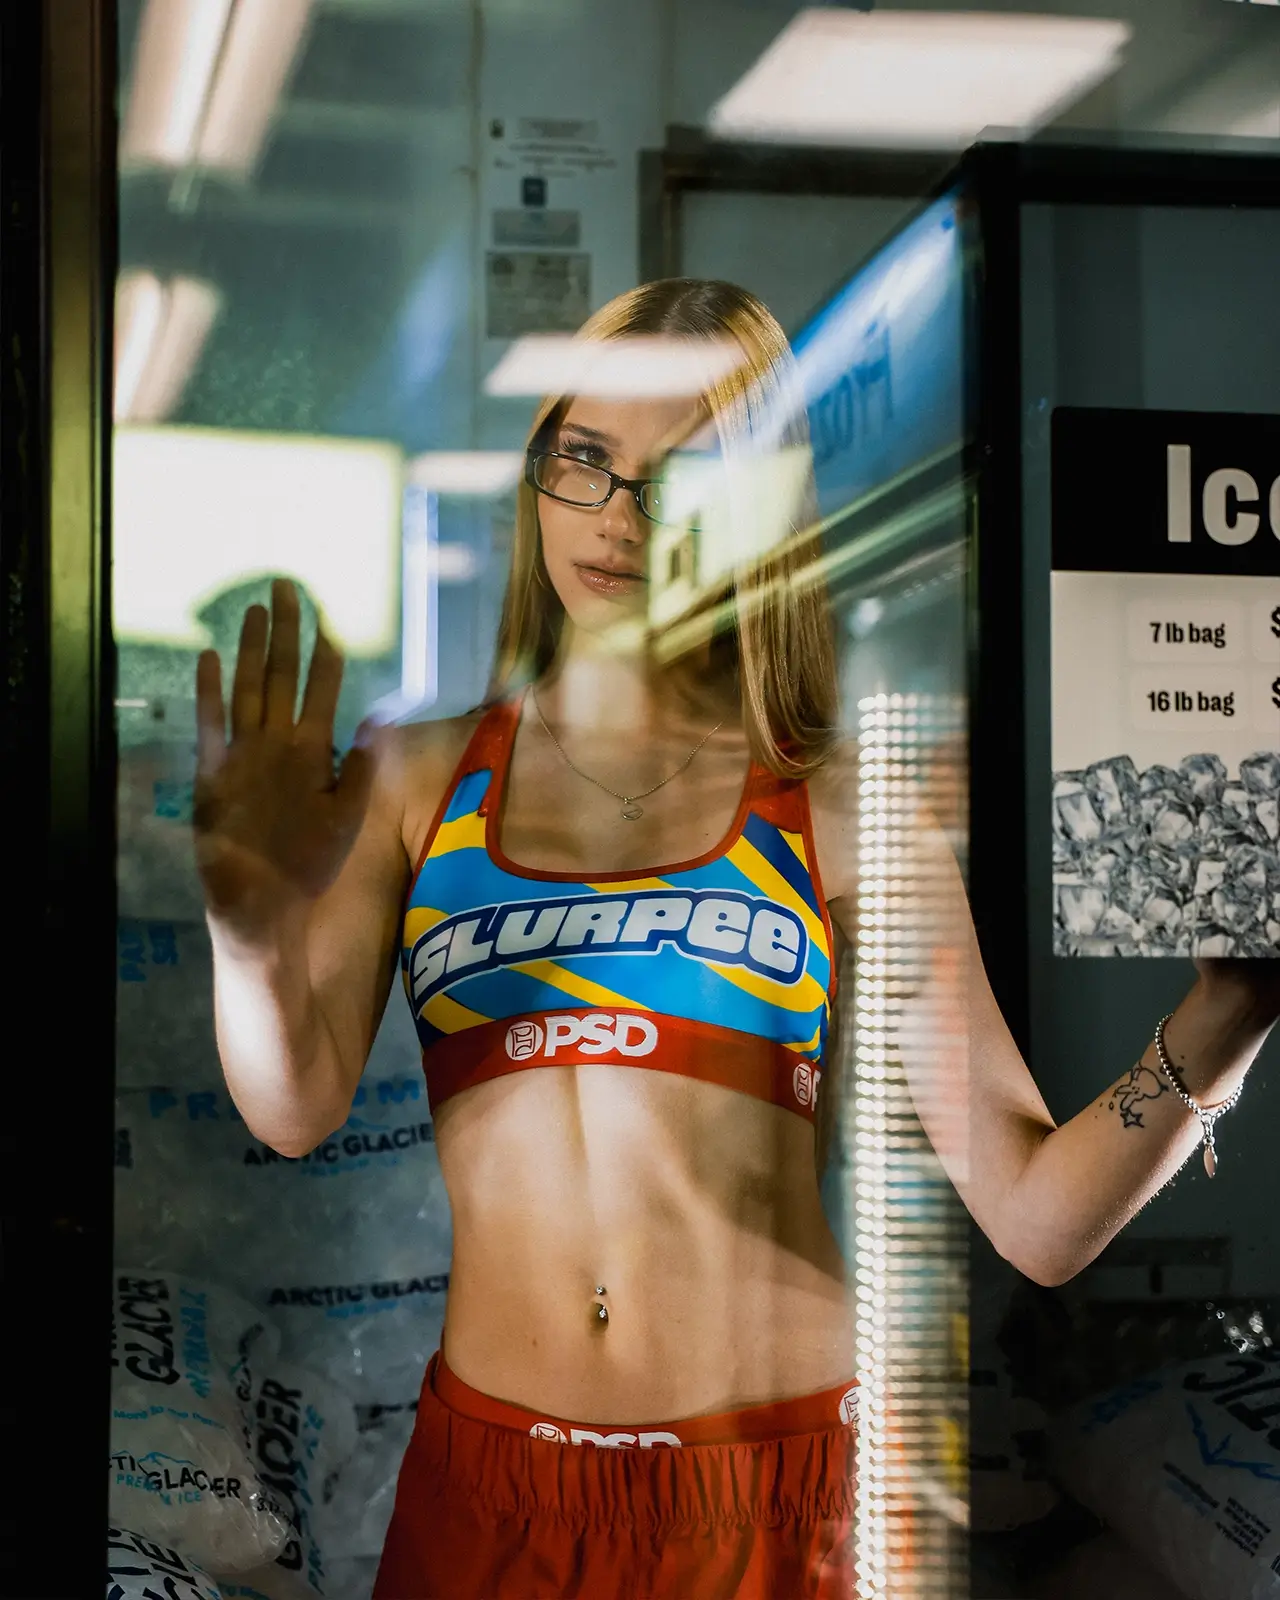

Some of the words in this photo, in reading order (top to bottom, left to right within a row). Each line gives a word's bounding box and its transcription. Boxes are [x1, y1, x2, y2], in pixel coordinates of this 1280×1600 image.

[1167, 444, 1280, 546] Ic
[1149, 622, 1162, 644] 7
[1166, 621, 1184, 644] lb
[1188, 621, 1226, 649] bag
[1146, 690, 1170, 712] 16
[1174, 690, 1193, 712] lb
[1197, 690, 1235, 717] bag
[543, 1013, 658, 1058] PSD
[342, 1123, 433, 1157] GLACIE
[146, 1467, 241, 1499] GLACER
[178, 1490, 202, 1505] ICE
